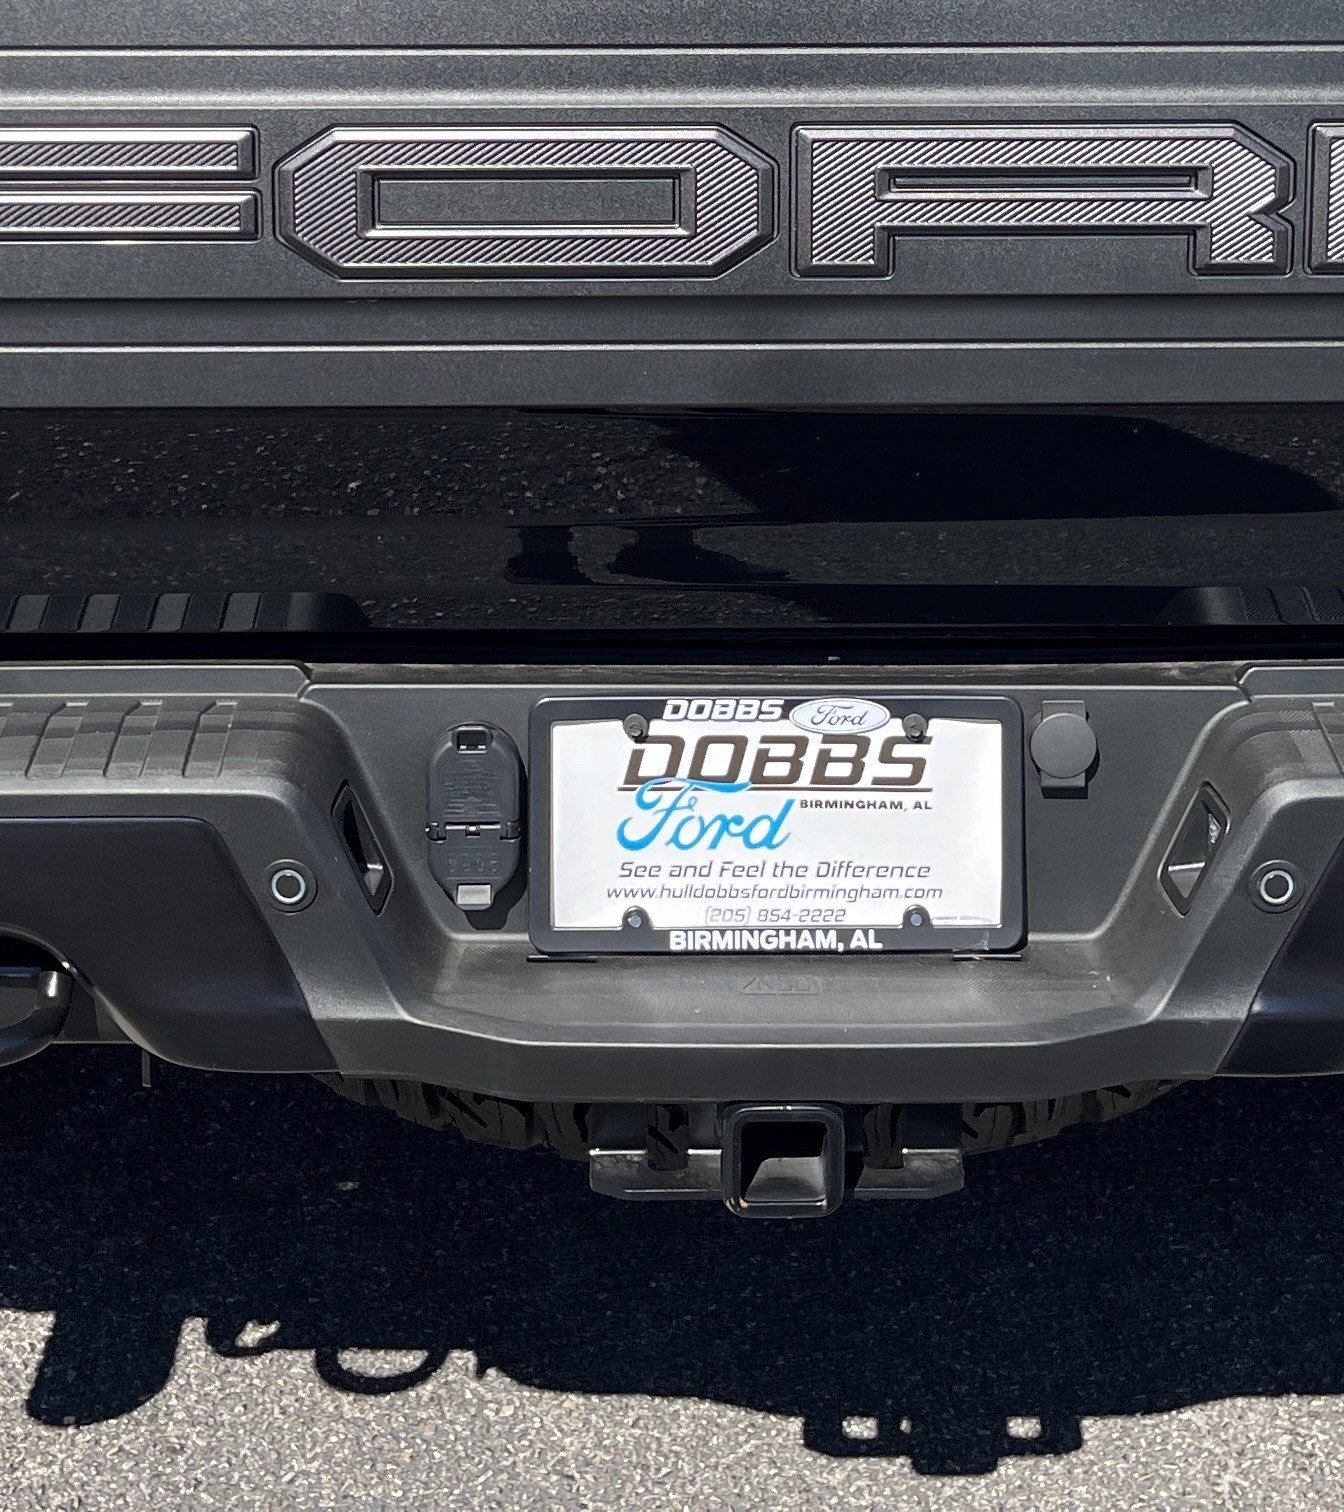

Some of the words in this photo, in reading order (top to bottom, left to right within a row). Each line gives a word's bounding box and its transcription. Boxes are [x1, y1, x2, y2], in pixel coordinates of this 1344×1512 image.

[662, 698, 786, 722] DOBBS
[810, 703, 868, 727] Ford
[624, 734, 933, 786] DOBBS
[616, 777, 796, 851] Ford
[800, 798, 908, 813] BIRMINGHAM,
[914, 799, 933, 811] AL
[618, 861, 662, 879] See
[669, 860, 711, 879] and
[718, 861, 765, 879] Feel
[771, 861, 808, 879] the
[815, 861, 932, 879] Difference
[606, 883, 944, 903] www.hulldobbsfordbirmingham.com
[704, 905, 753, 925] (205)
[757, 907, 847, 924] 854-2222
[669, 929, 844, 952] BIRMINGHAM,
[850, 930, 883, 950] AL
